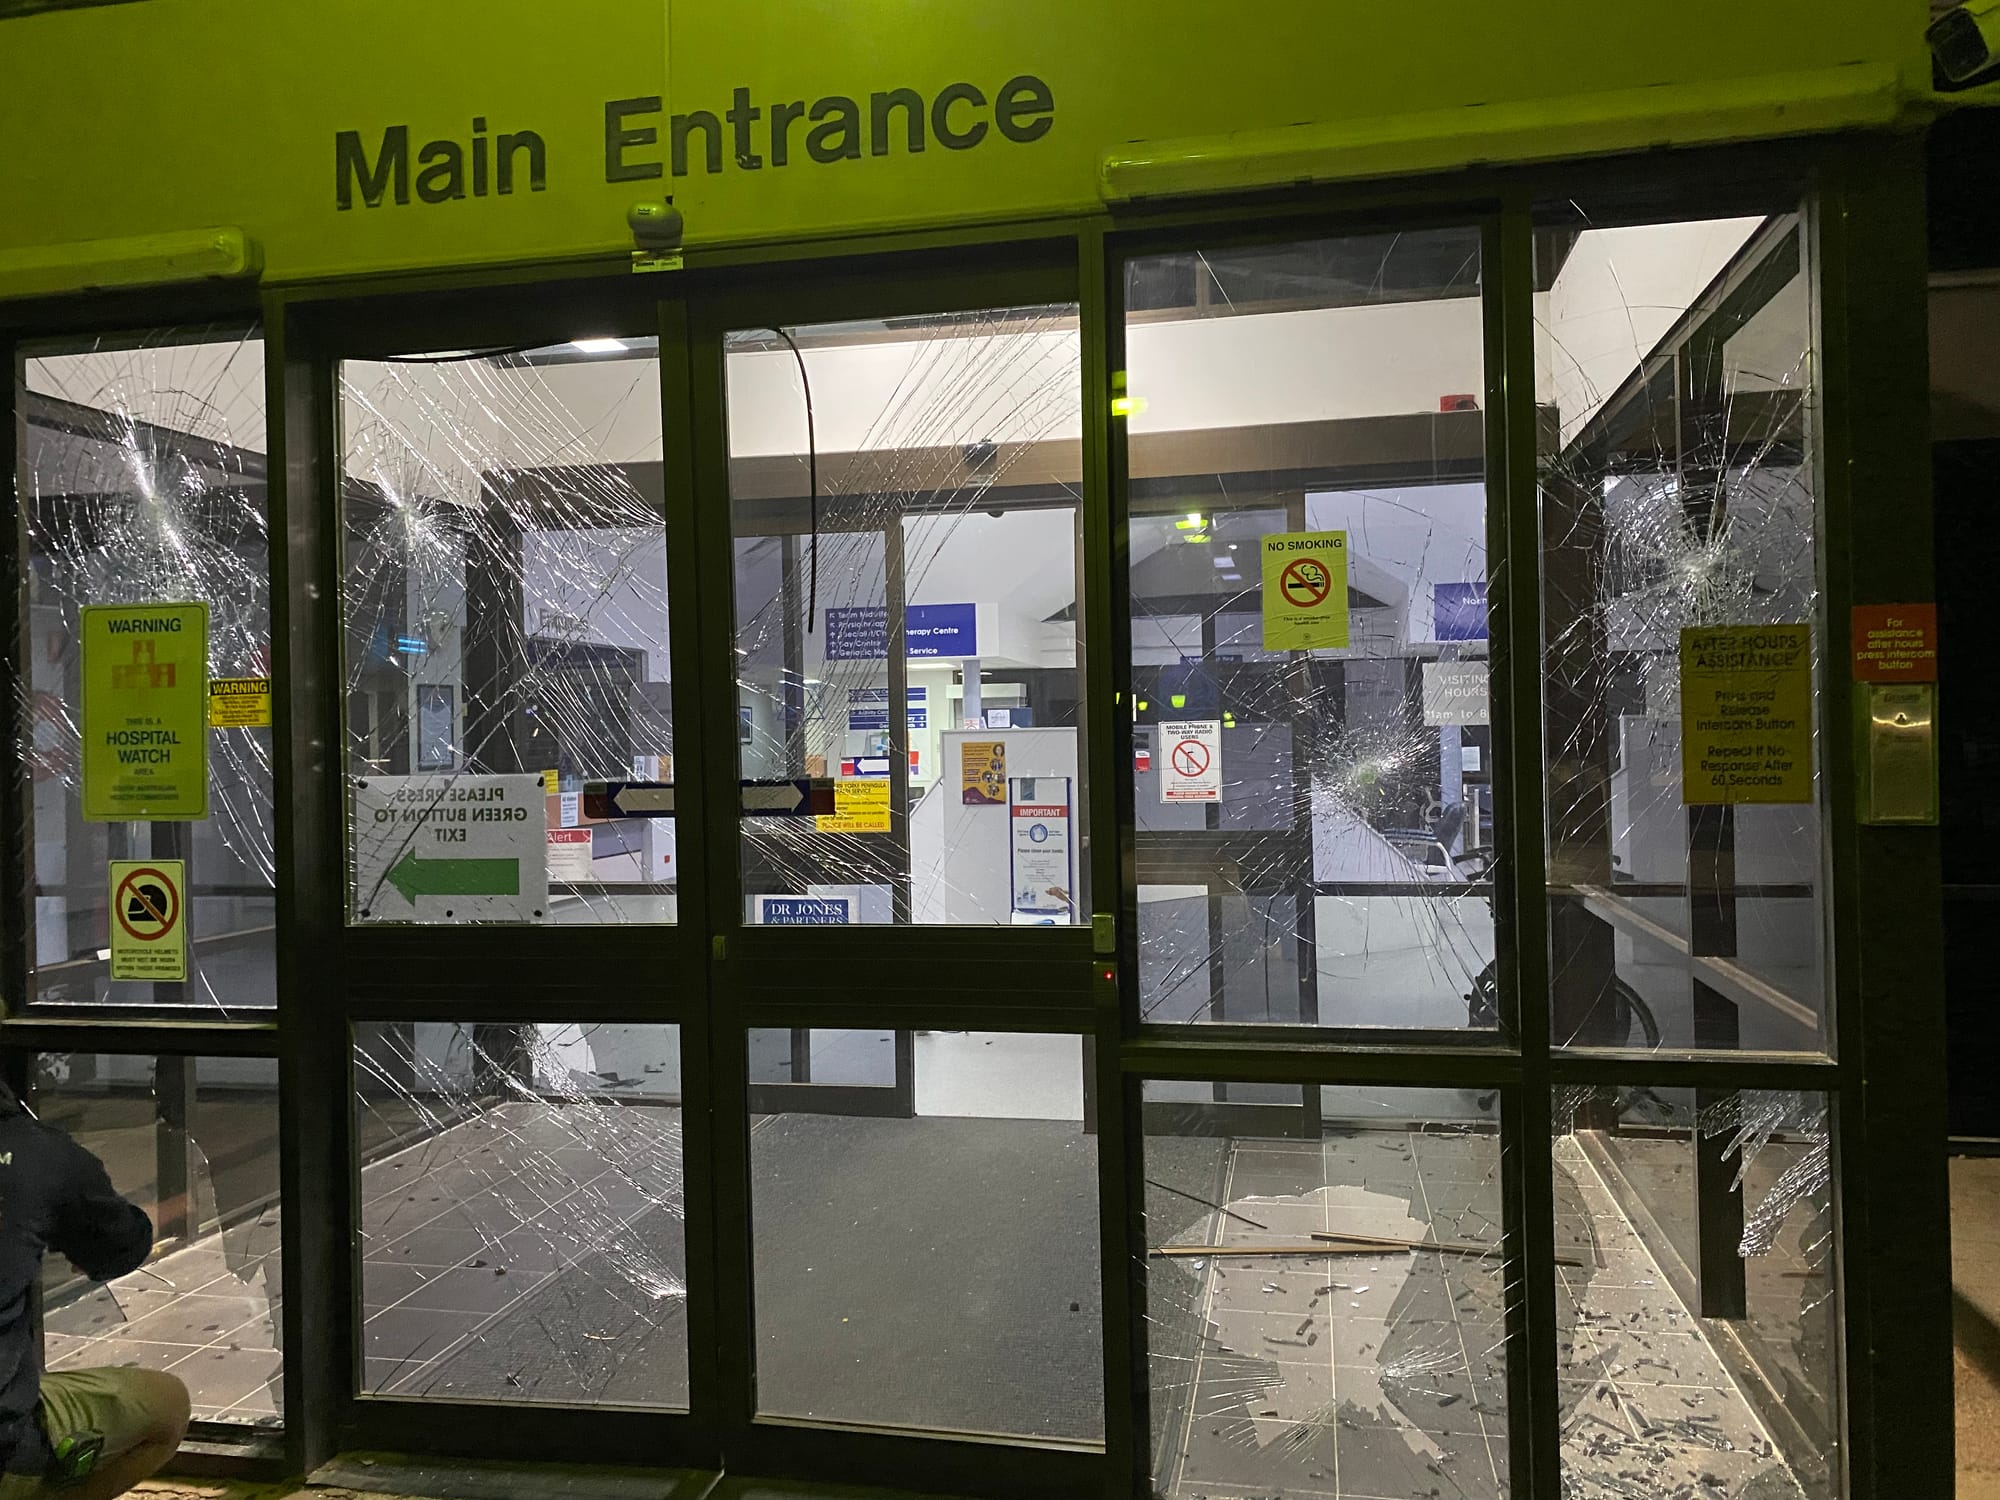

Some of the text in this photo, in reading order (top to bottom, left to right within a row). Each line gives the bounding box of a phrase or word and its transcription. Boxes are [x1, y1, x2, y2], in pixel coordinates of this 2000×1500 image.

[336, 75, 1055, 211] Main Entrance
[1268, 538, 1343, 552] NO SMOKING
[108, 618, 182, 634] WARNING
[1887, 617, 1904, 627] For
[933, 627, 959, 635] Centre
[1867, 629, 1924, 638] assistance
[1867, 639, 1924, 648] after hours
[910, 647, 938, 655] Service
[1856, 650, 1935, 660] press intercom
[1696, 653, 1793, 668] ASSISTANCE
[1878, 660, 1913, 670] button
[212, 681, 268, 694] WARNING
[1444, 687, 1488, 697] HOURS
[1715, 690, 1746, 702] Press
[1461, 709, 1473, 719] to
[1720, 705, 1770, 716] Release
[1697, 719, 1795, 731] Intercom Button
[106, 731, 181, 746] HOSPITAL
[118, 749, 170, 764] WATCH
[1708, 745, 1785, 758] Repeat If No
[1701, 759, 1793, 773] Response After
[1711, 774, 1783, 786] 60 Seconds
[1020, 808, 1061, 817] IMPORTANT
[771, 903, 843, 916] DR JONES
[771, 915, 843, 924] & PARTNERS
